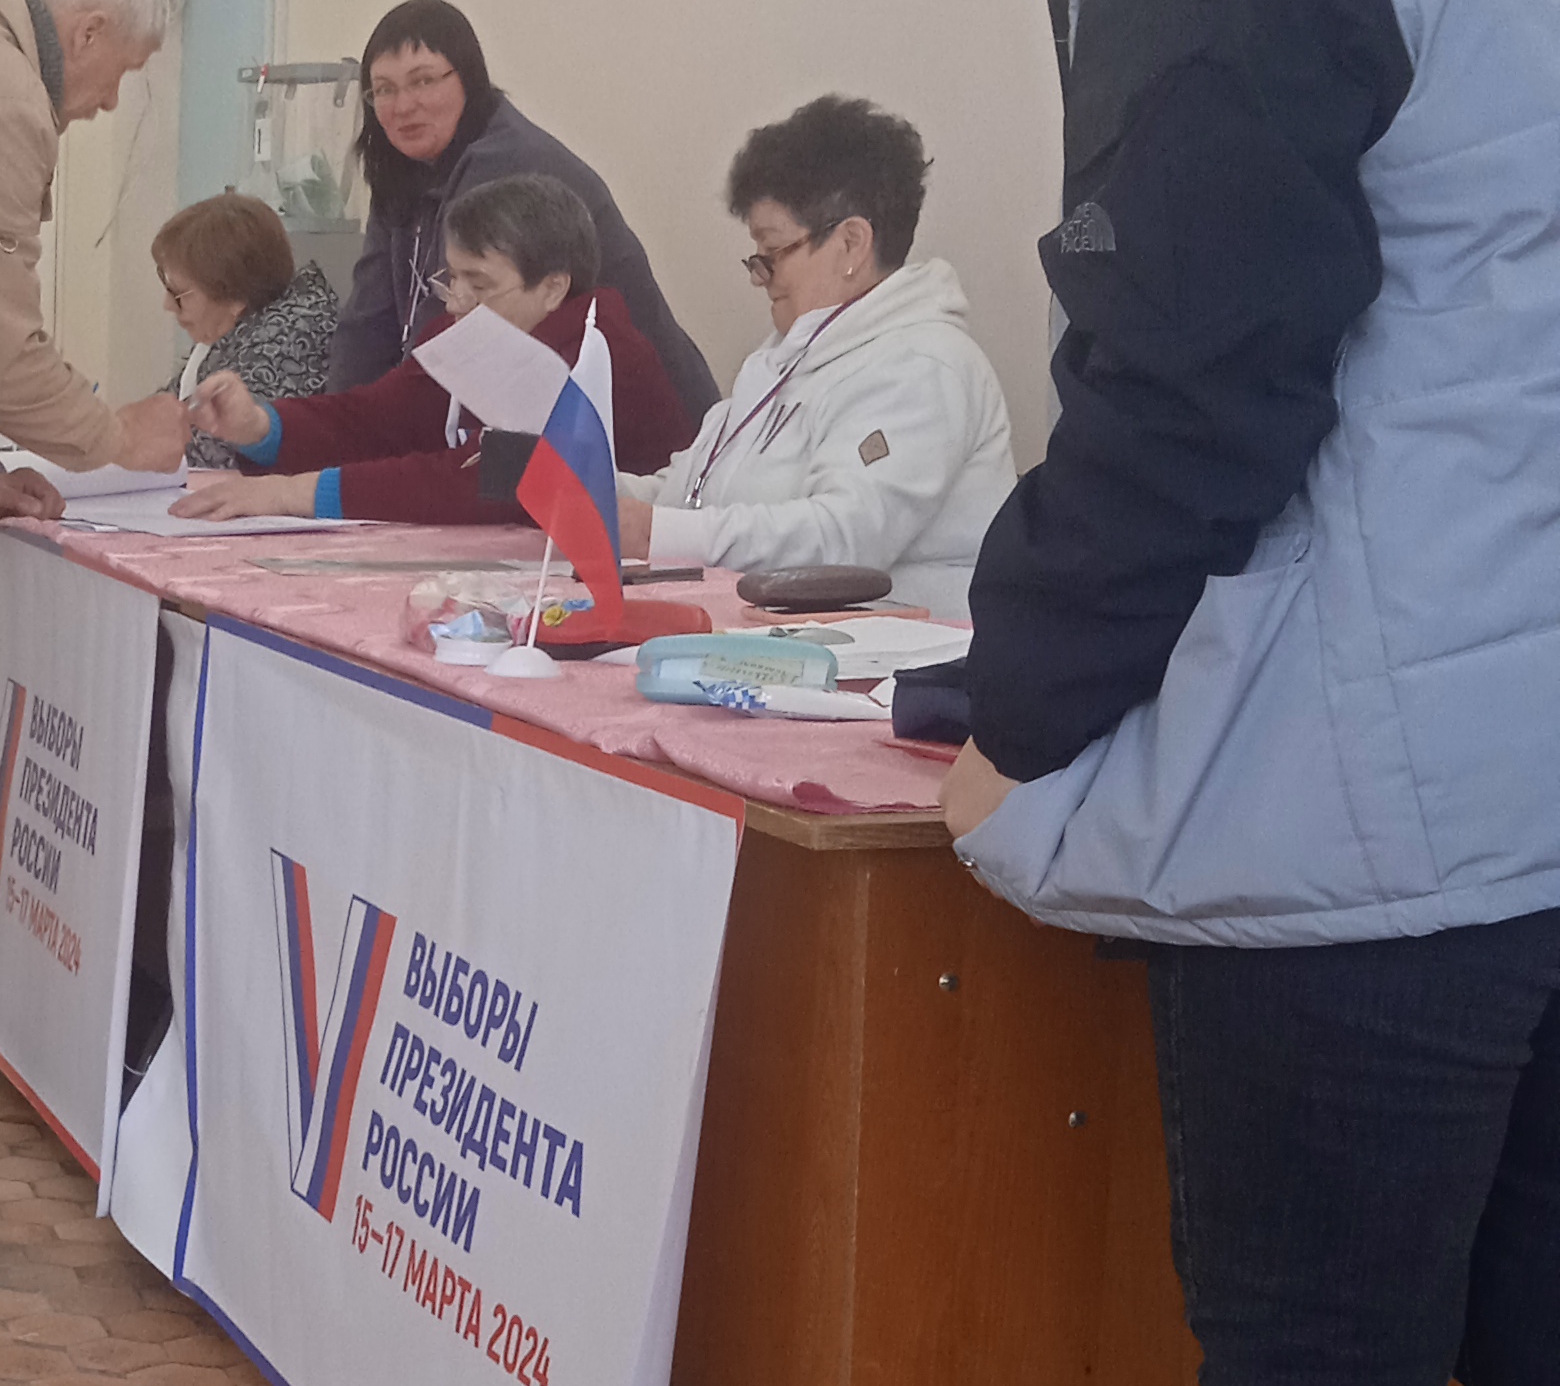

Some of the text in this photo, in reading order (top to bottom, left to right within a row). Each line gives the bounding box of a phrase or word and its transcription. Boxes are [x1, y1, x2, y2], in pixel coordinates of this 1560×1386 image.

[29, 695, 84, 771] ВЫБОРЫ
[9, 816, 62, 895] РОССИИ
[19, 756, 99, 856] ПРЕЗИДЕНТА
[27, 894, 61, 957] МАРТА
[56, 922, 82, 976] 2024
[402, 930, 539, 1072] ВЫБОРЫ
[380, 1021, 585, 1218] ПРЕЗИДЕНТА
[361, 1108, 481, 1254] РОССИИ
[402, 1238, 482, 1349] МАРТА
